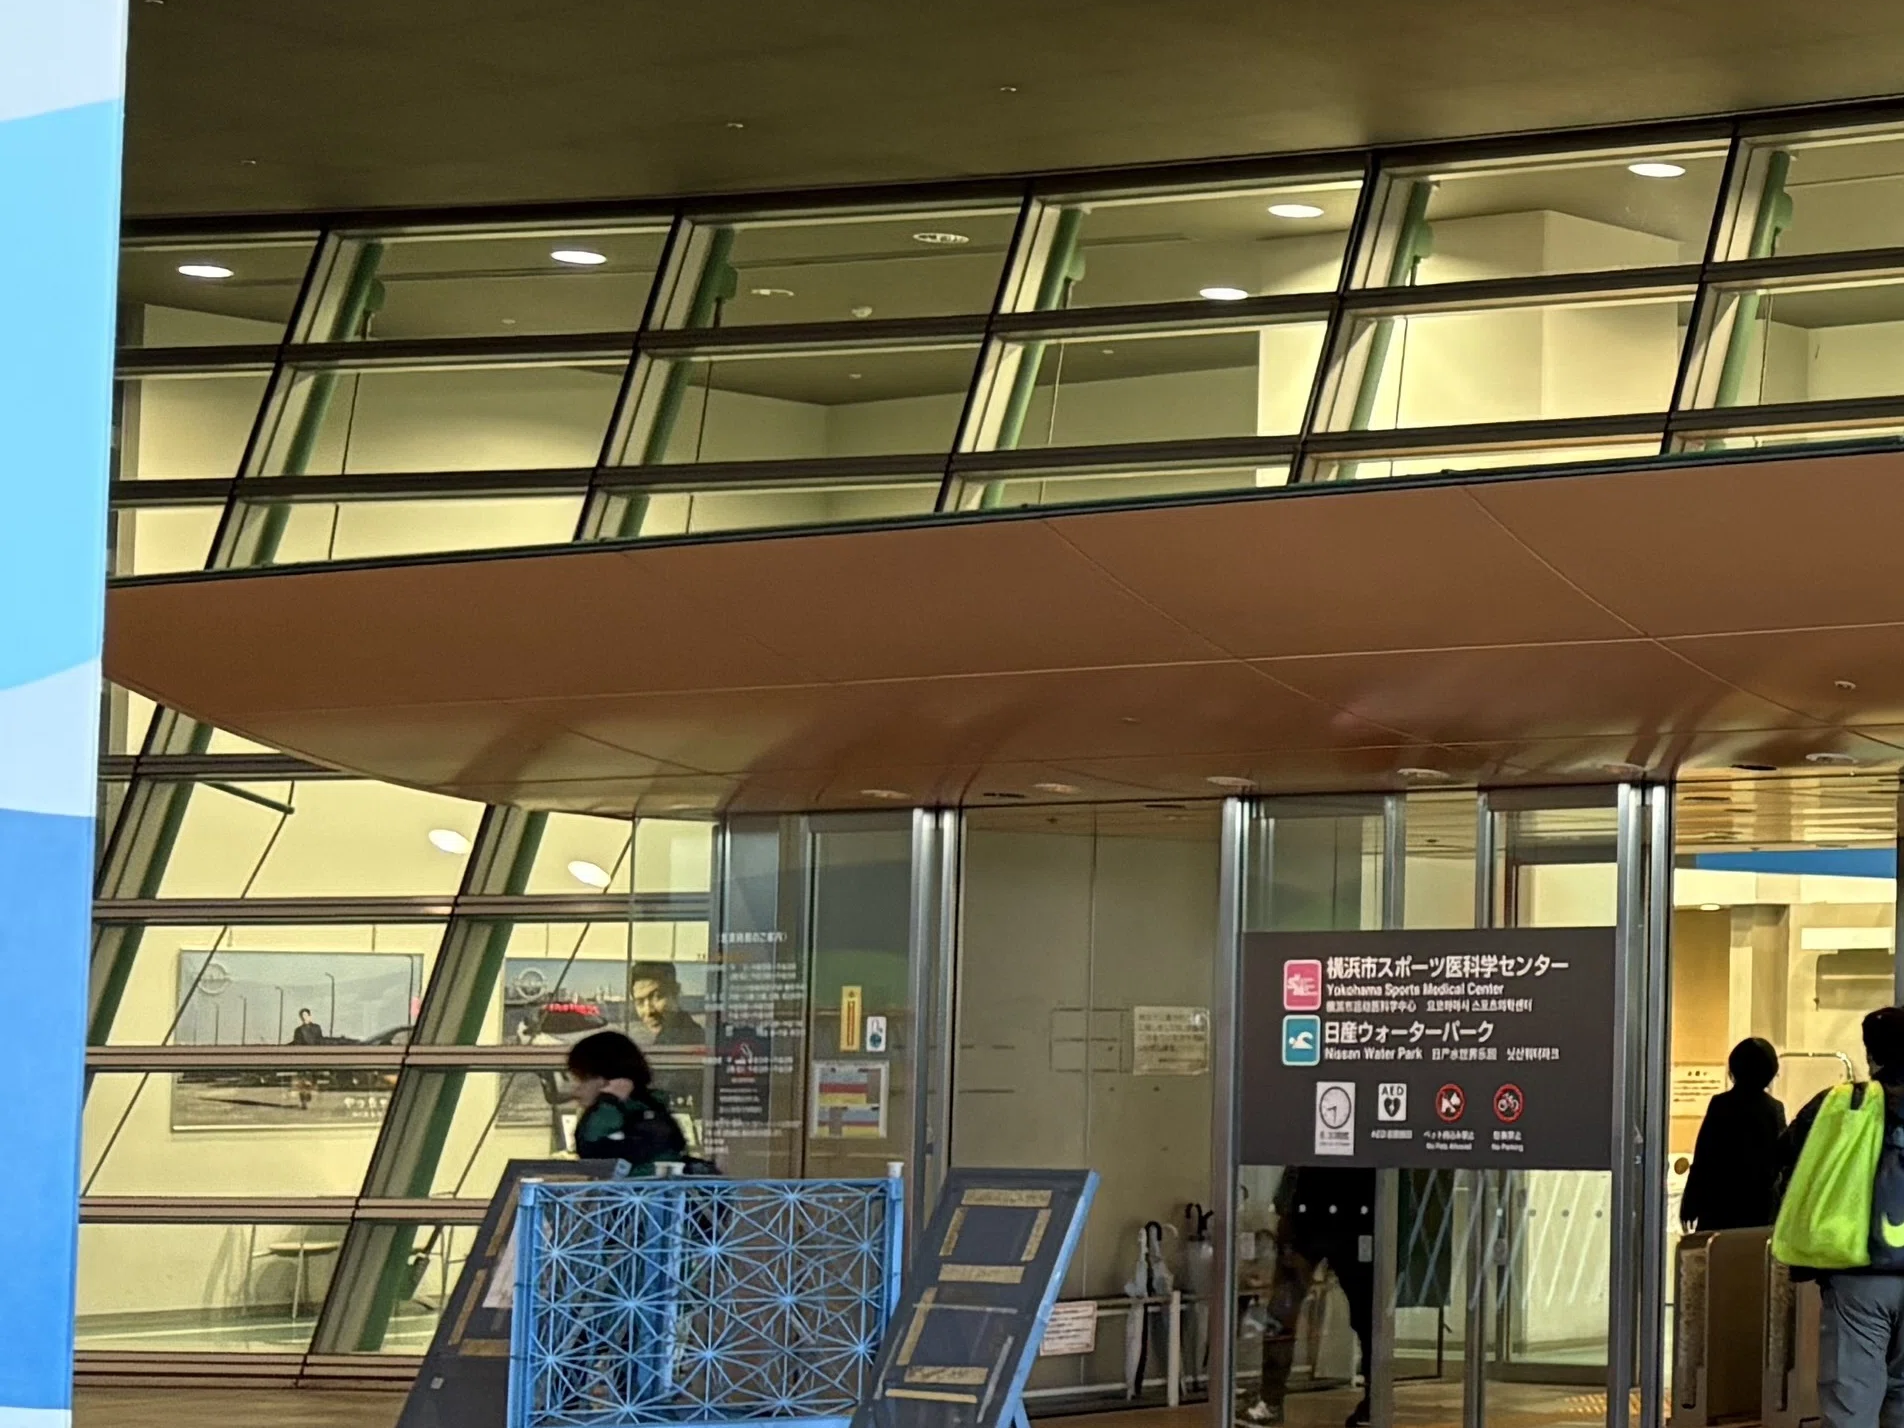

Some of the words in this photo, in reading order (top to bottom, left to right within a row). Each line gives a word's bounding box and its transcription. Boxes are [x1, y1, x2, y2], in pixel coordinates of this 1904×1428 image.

[1327, 954, 1569, 979] 横浜市スポーツ医科学センター
[1326, 983, 1383, 997] Yokohama
[1384, 982, 1420, 998] Sports
[1422, 981, 1465, 997] Medical
[1467, 982, 1504, 996] Center
[1324, 1019, 1494, 1044] 日産ウォーターパーク
[1324, 1047, 1361, 1061] Nissan
[1364, 1047, 1396, 1060] Water
[1397, 1046, 1423, 1060] Park
[1381, 1086, 1404, 1096] AED
